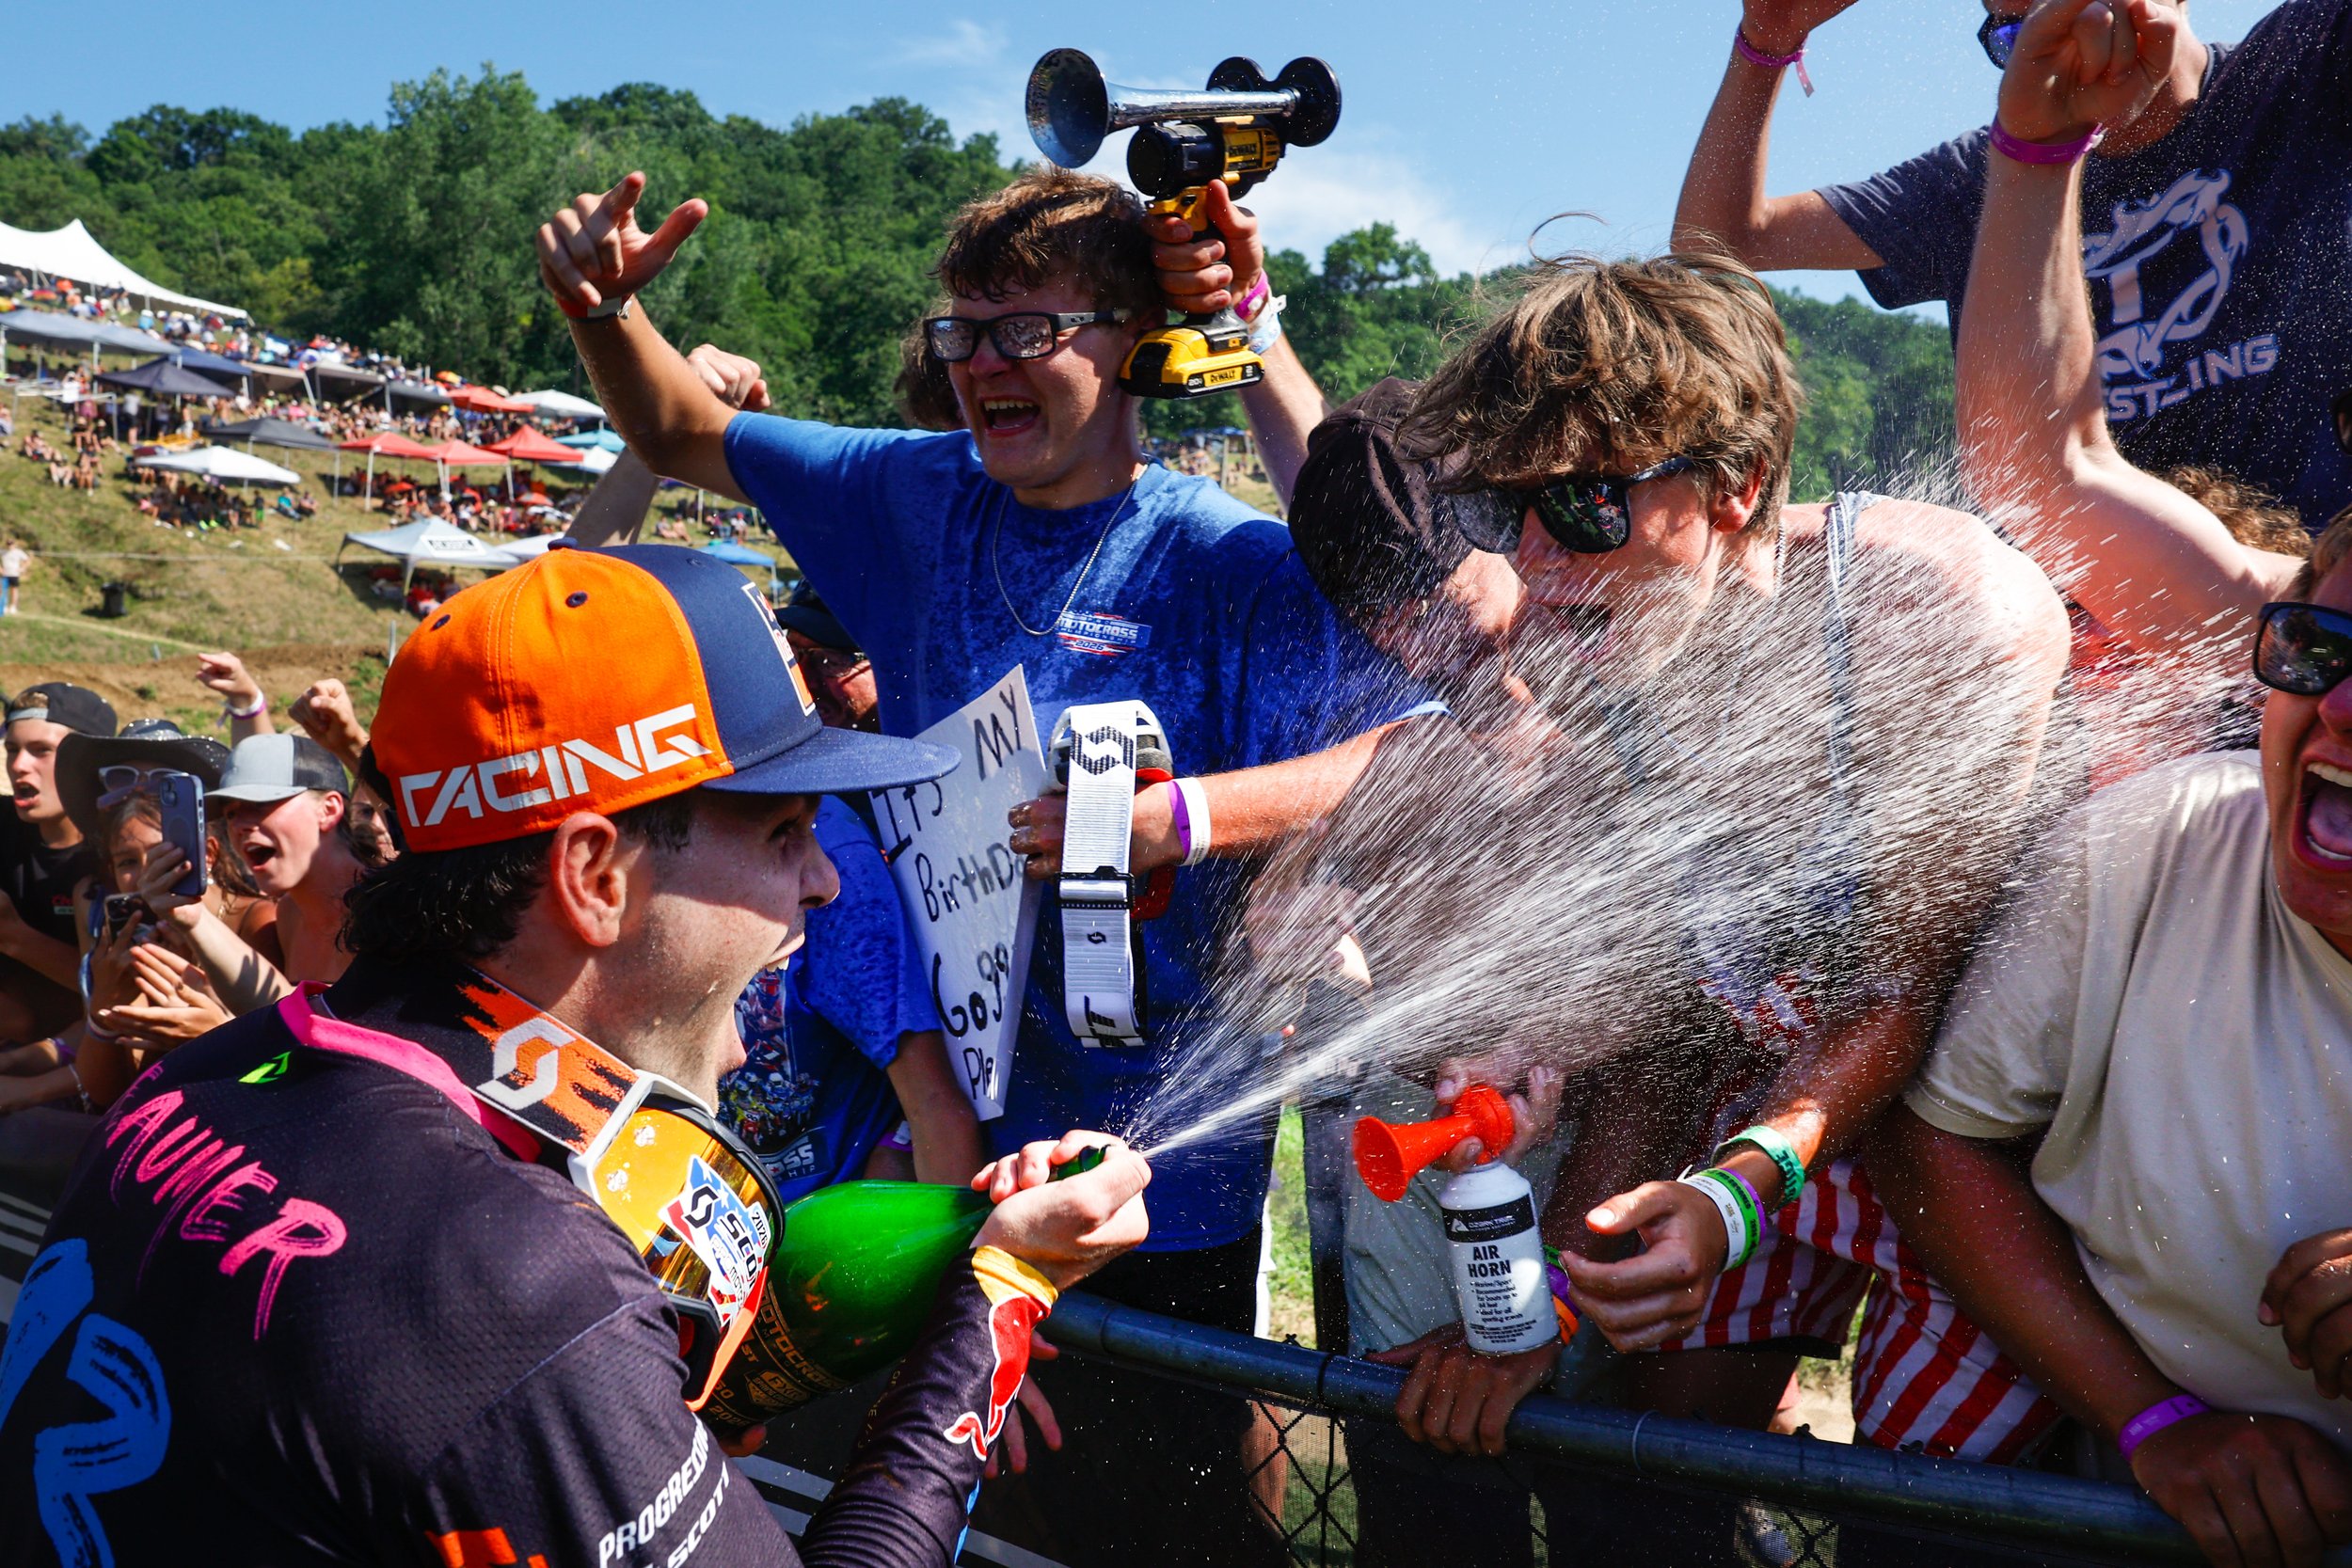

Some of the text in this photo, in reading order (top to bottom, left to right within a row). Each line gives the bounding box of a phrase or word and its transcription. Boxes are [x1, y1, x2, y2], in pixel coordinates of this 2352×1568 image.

[1060, 618, 1138, 640] MOTOCROSS
[1075, 640, 1104, 651] 2026
[974, 684, 1022, 781] MY
[399, 703, 713, 828] RACING
[752, 1212, 768, 1249] 2026
[1473, 1244, 1500, 1260] AIR
[1468, 1259, 1512, 1277] HORN
